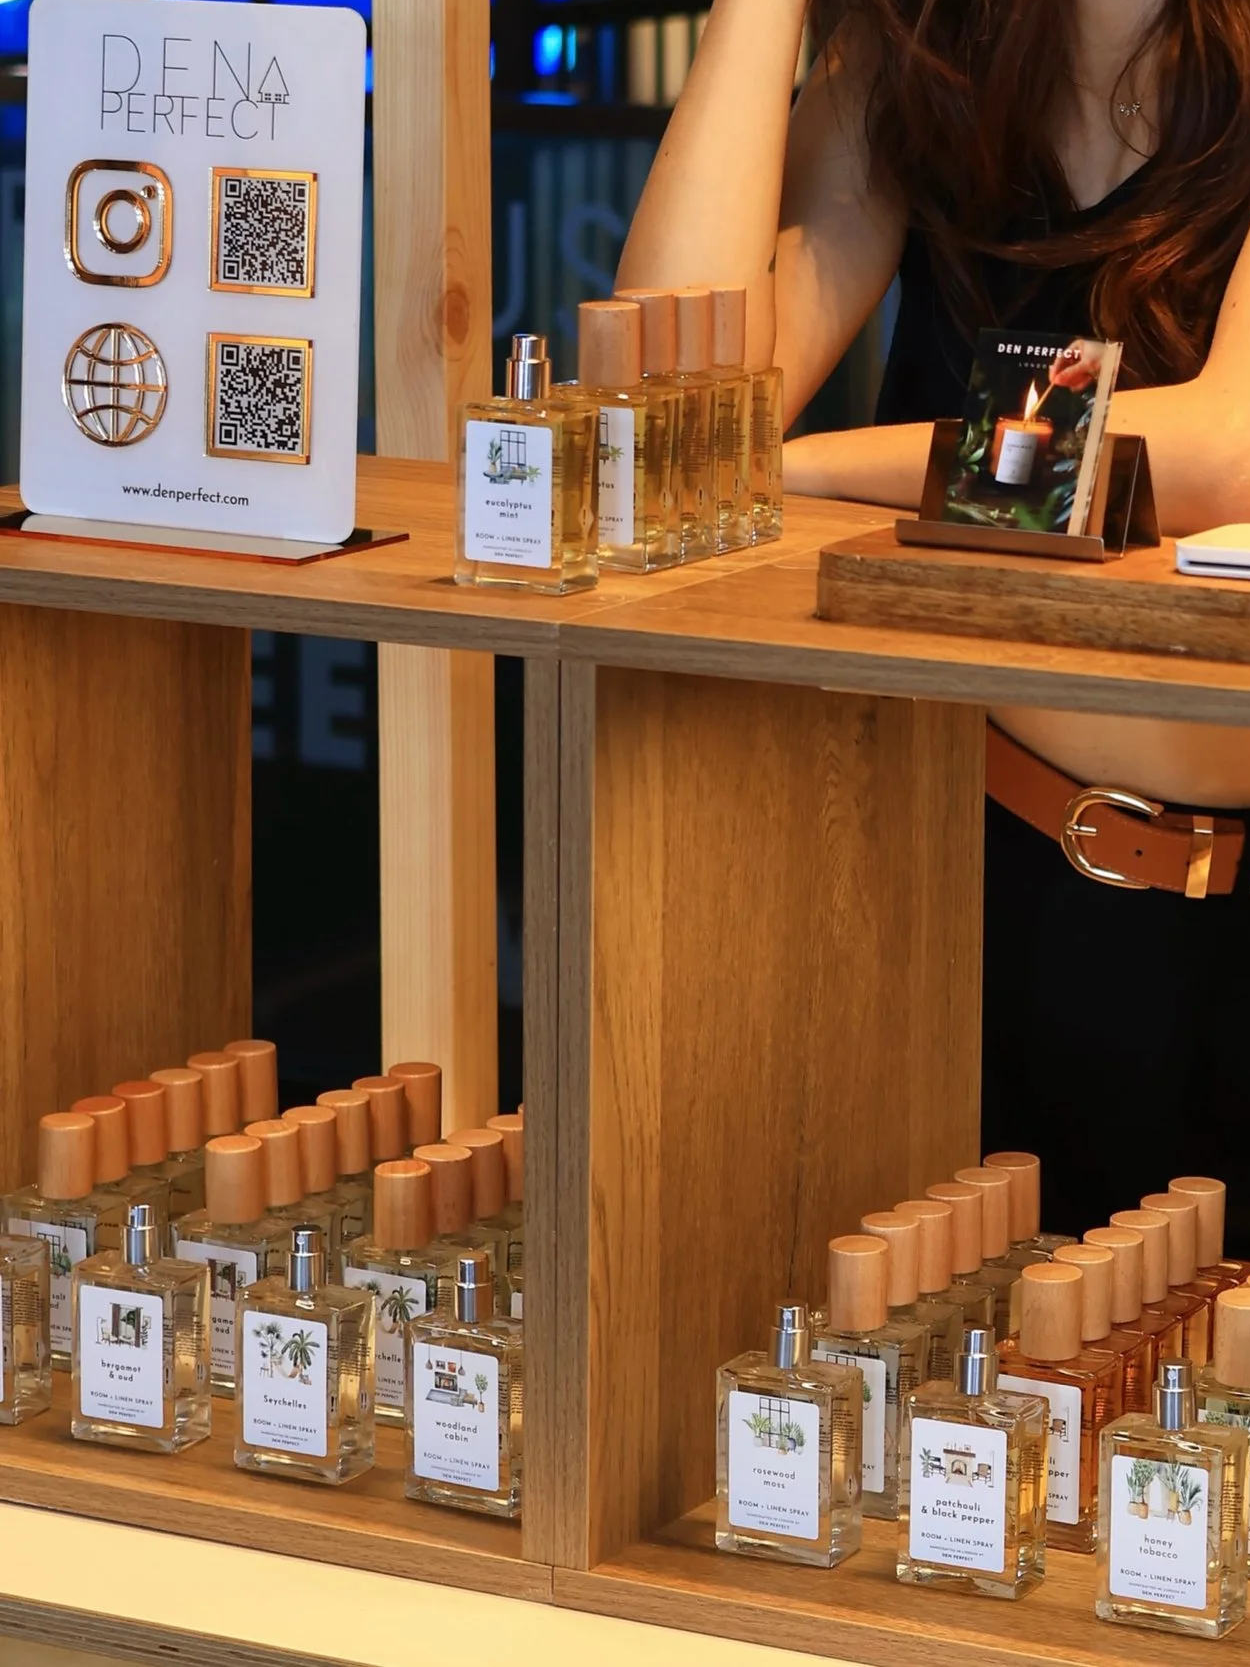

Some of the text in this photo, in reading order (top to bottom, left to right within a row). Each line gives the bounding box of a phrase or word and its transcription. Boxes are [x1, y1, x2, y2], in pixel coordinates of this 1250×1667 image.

[101, 91, 289, 140] PERFECT
[997, 343, 1082, 359] DEN PERFECT
[122, 483, 249, 506] www.denperfect.com
[486, 499, 532, 510] eucalyptus
[101, 1359, 140, 1373] bergamot
[264, 1395, 306, 1409] Seychelles
[436, 1421, 477, 1434] woodland
[445, 1433, 468, 1442] cabin
[753, 1468, 795, 1479] rosewood
[764, 1480, 785, 1489] moss
[936, 1499, 980, 1511] patchouli
[932, 1507, 957, 1518] black
[962, 1515, 994, 1524] pepper
[950, 1537, 970, 1545] LINEN
[1144, 1534, 1172, 1549] honey
[1139, 1546, 1178, 1559] tobacco
[1120, 1568, 1141, 1577] ROOM
[1150, 1574, 1172, 1582] LINEN
[1175, 1578, 1196, 1586] SPRAY
